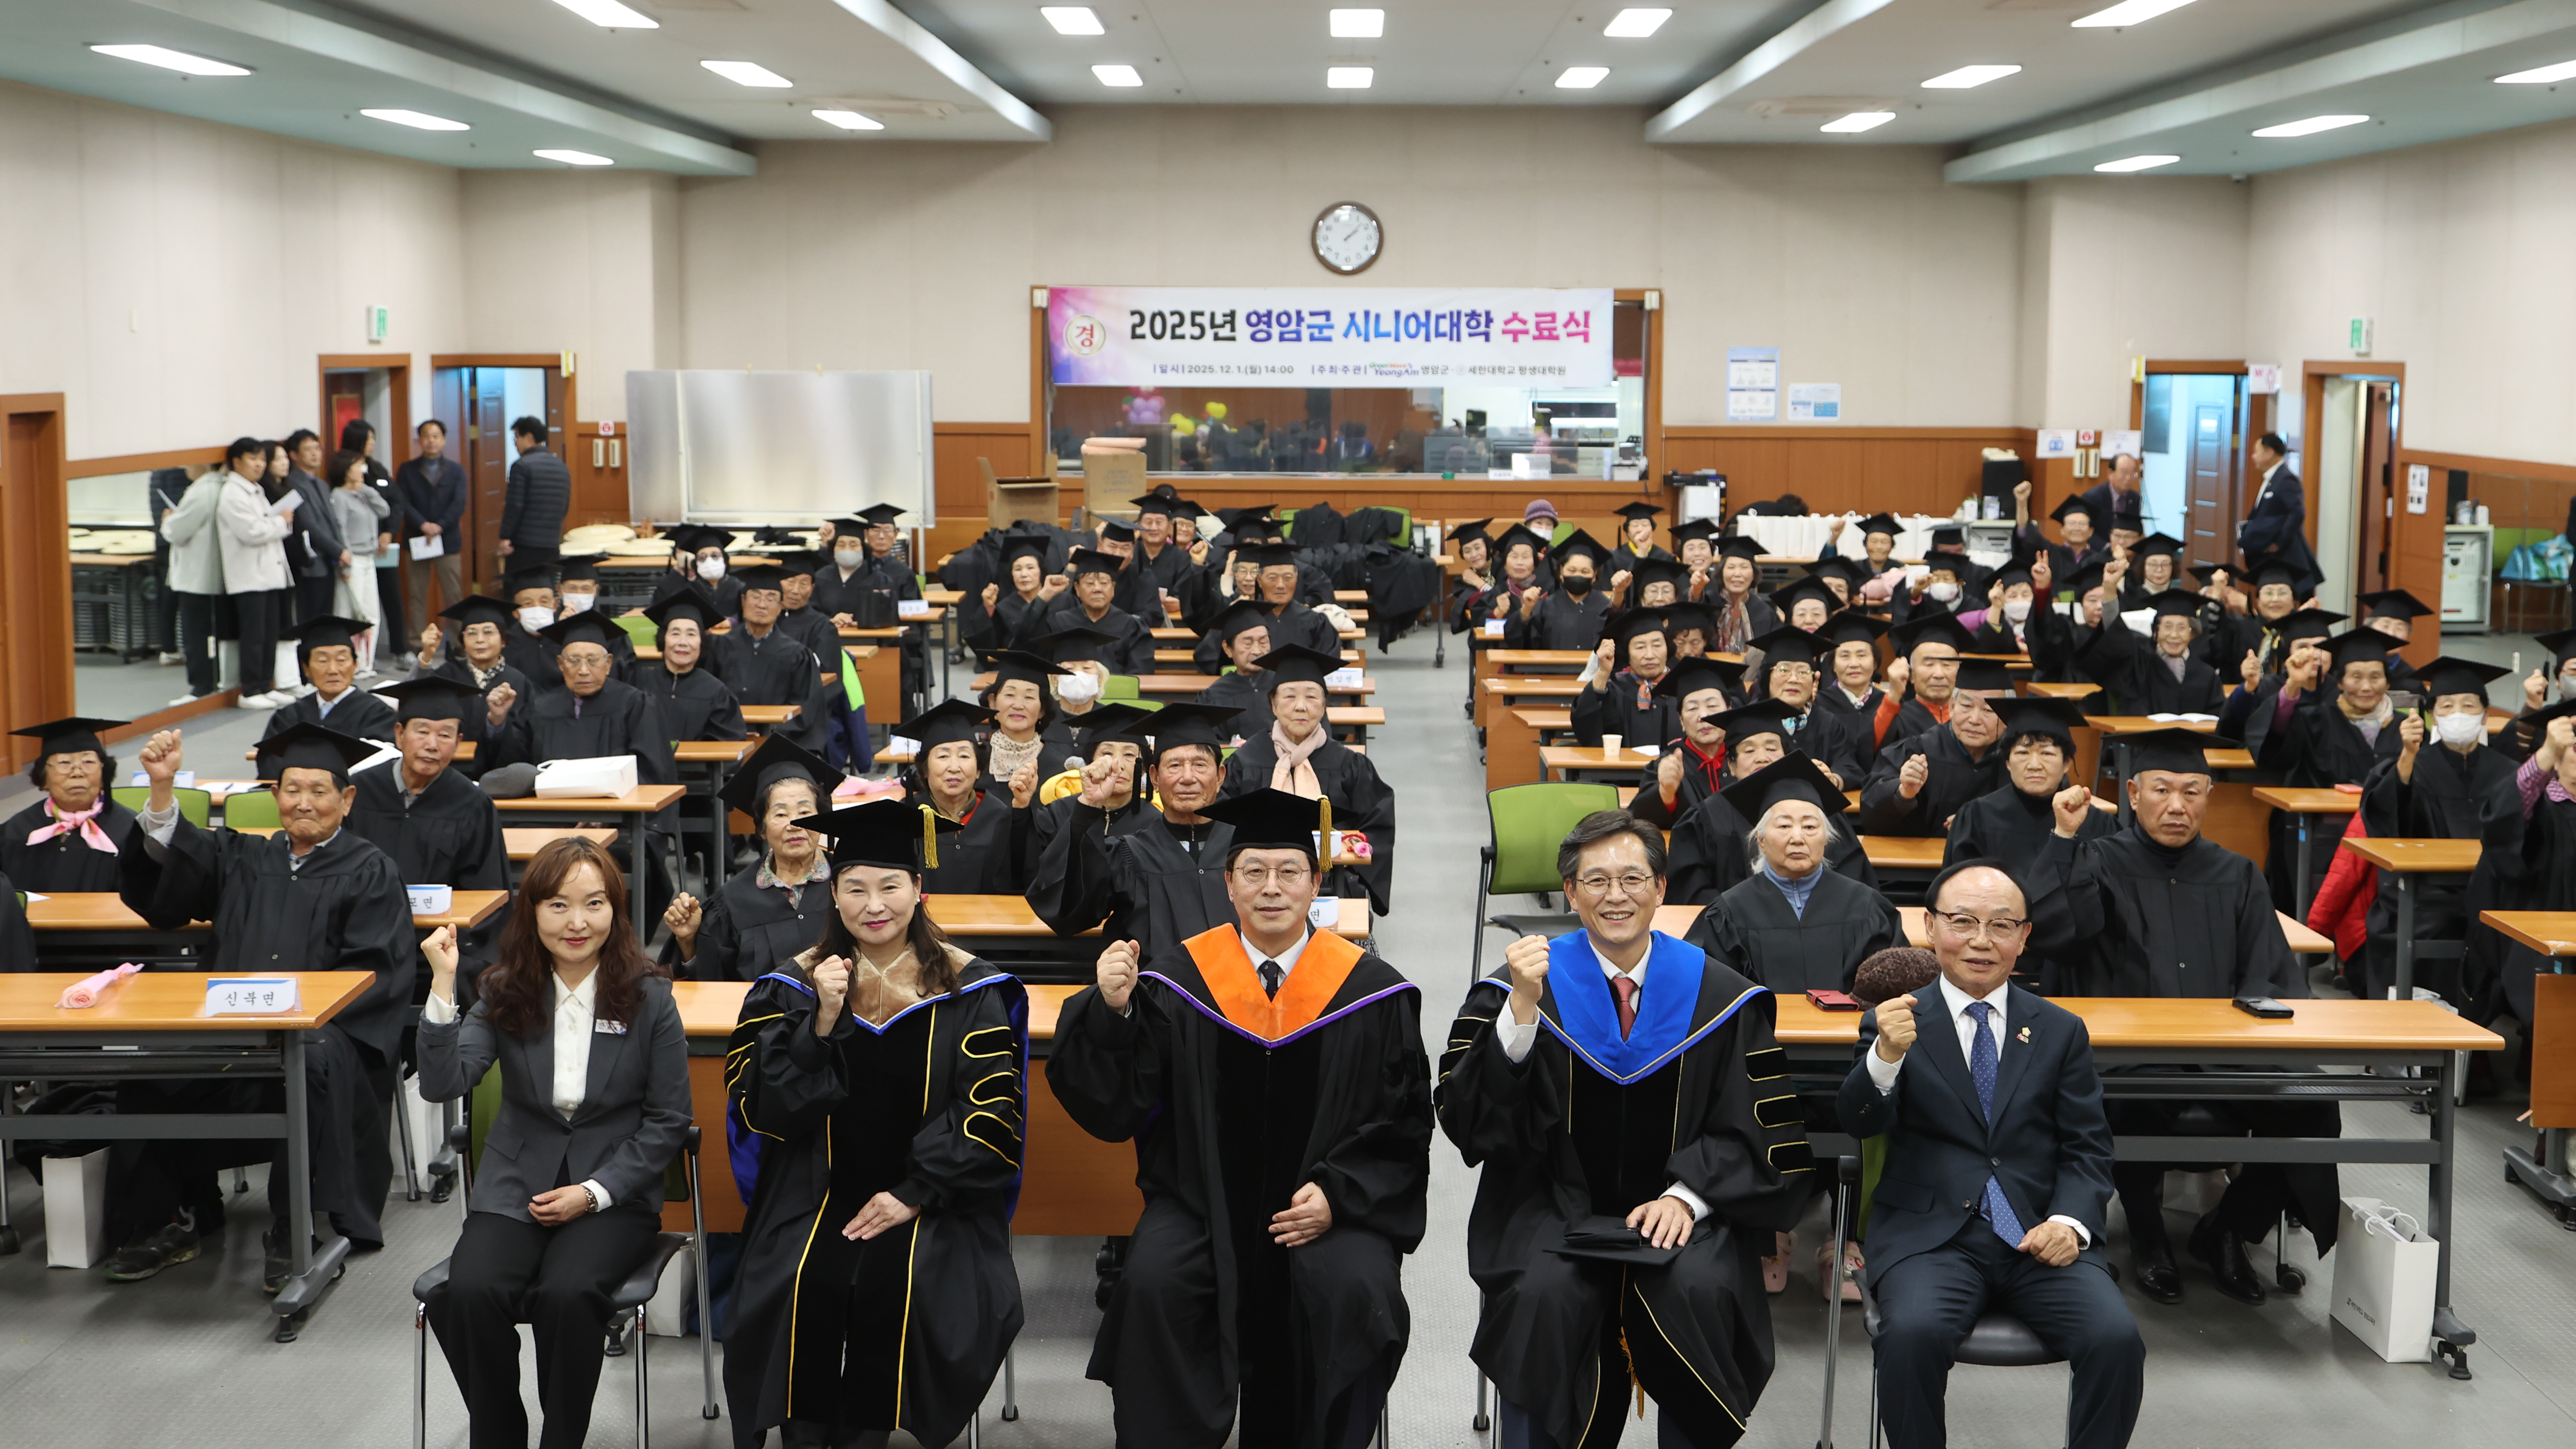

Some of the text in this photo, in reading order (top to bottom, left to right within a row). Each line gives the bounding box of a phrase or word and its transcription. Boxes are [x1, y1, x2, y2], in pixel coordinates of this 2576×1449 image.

[1130, 309, 1591, 343] 2025년 영암군 시니어대학 수료식
[1075, 323, 1095, 348] 경
[1265, 365, 1294, 373] 14:00
[1375, 368, 1419, 377] YeongAm
[1421, 364, 1449, 375] 영암군
[1468, 365, 1516, 375] 세한대학교
[1518, 365, 1566, 376] 평생대학원
[1310, 908, 1320, 922] 면
[225, 991, 274, 1006] 신북면
